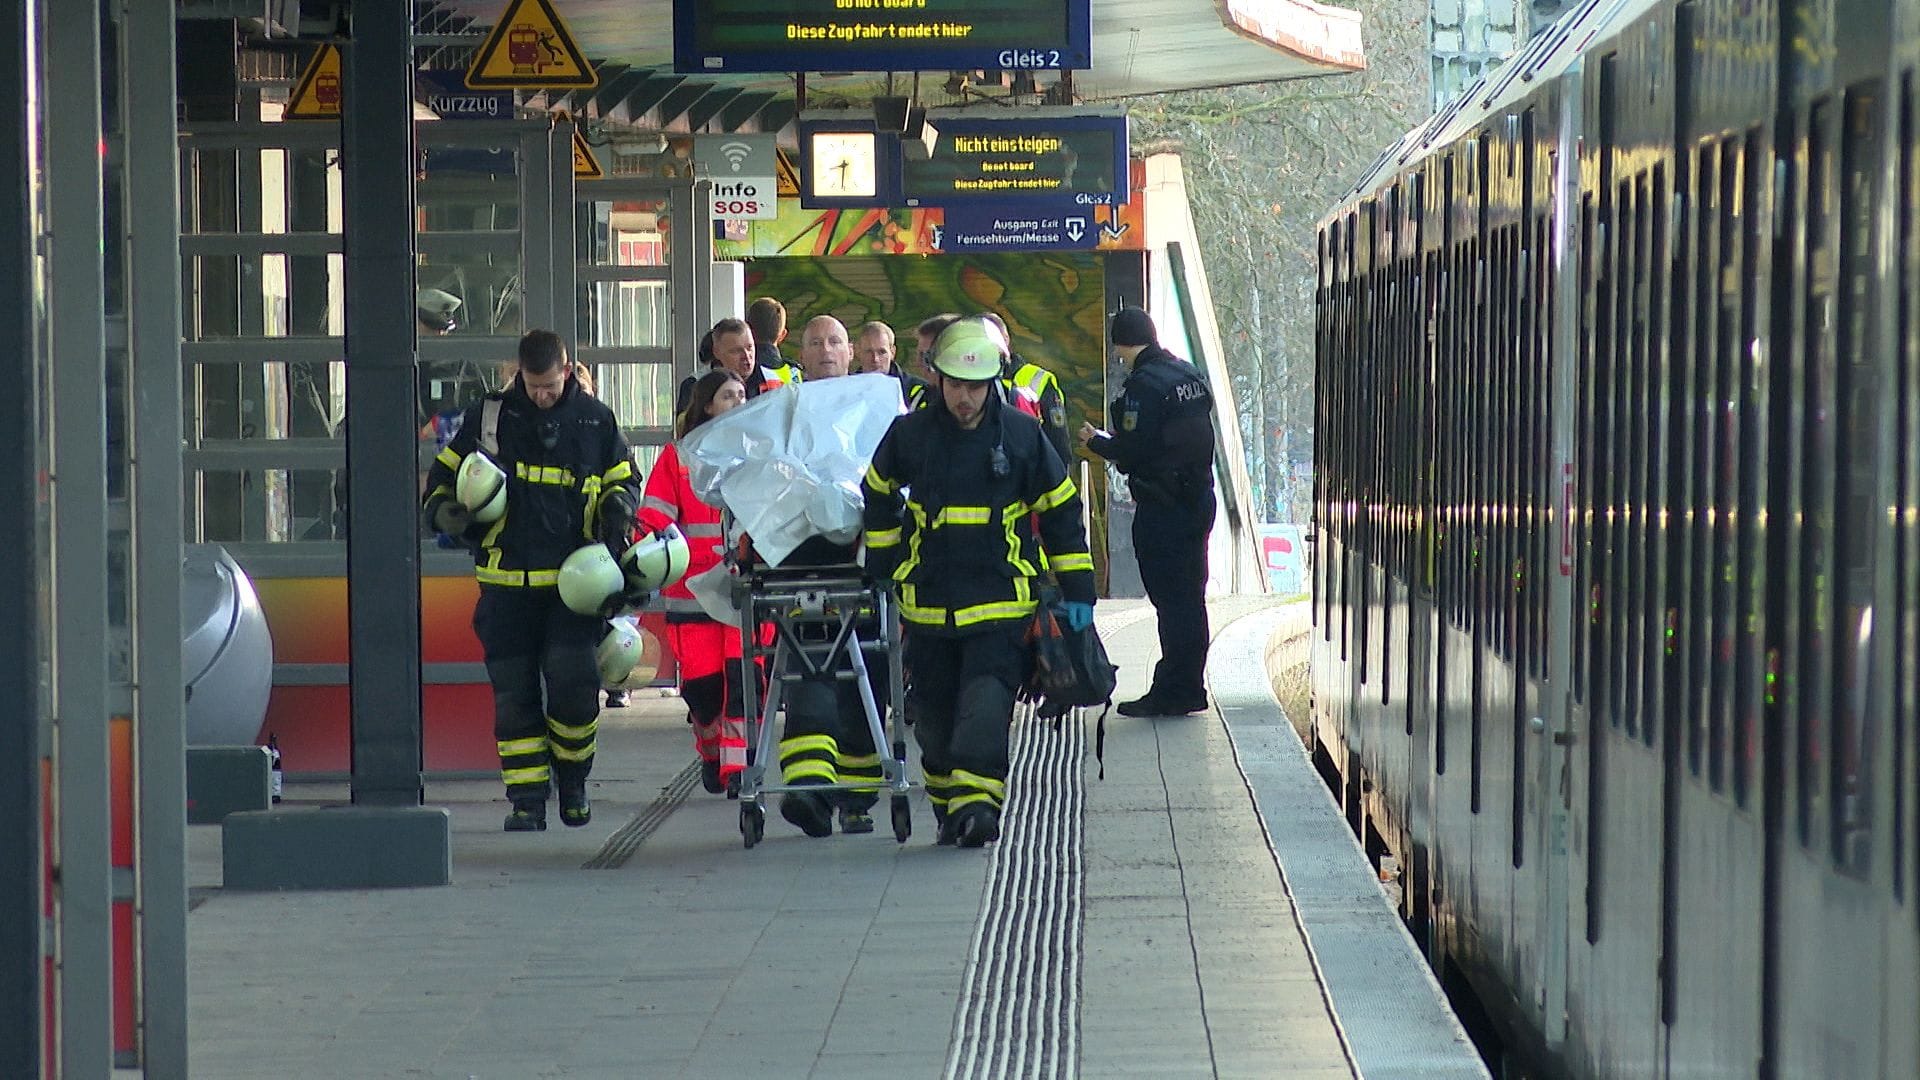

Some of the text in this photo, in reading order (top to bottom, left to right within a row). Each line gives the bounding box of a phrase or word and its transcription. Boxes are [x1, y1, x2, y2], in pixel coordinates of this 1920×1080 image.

[787, 24, 972, 41] Diese Zugfahrt endet hier
[999, 49, 1060, 67] Gleis 2
[428, 95, 498, 116] Kurzzug
[955, 136, 1058, 154] Nicht einsteigen
[715, 182, 756, 197] Info
[1075, 193, 1112, 204] Gleis 2
[715, 201, 758, 214] SOS
[993, 219, 1059, 231] Ausgang Exit
